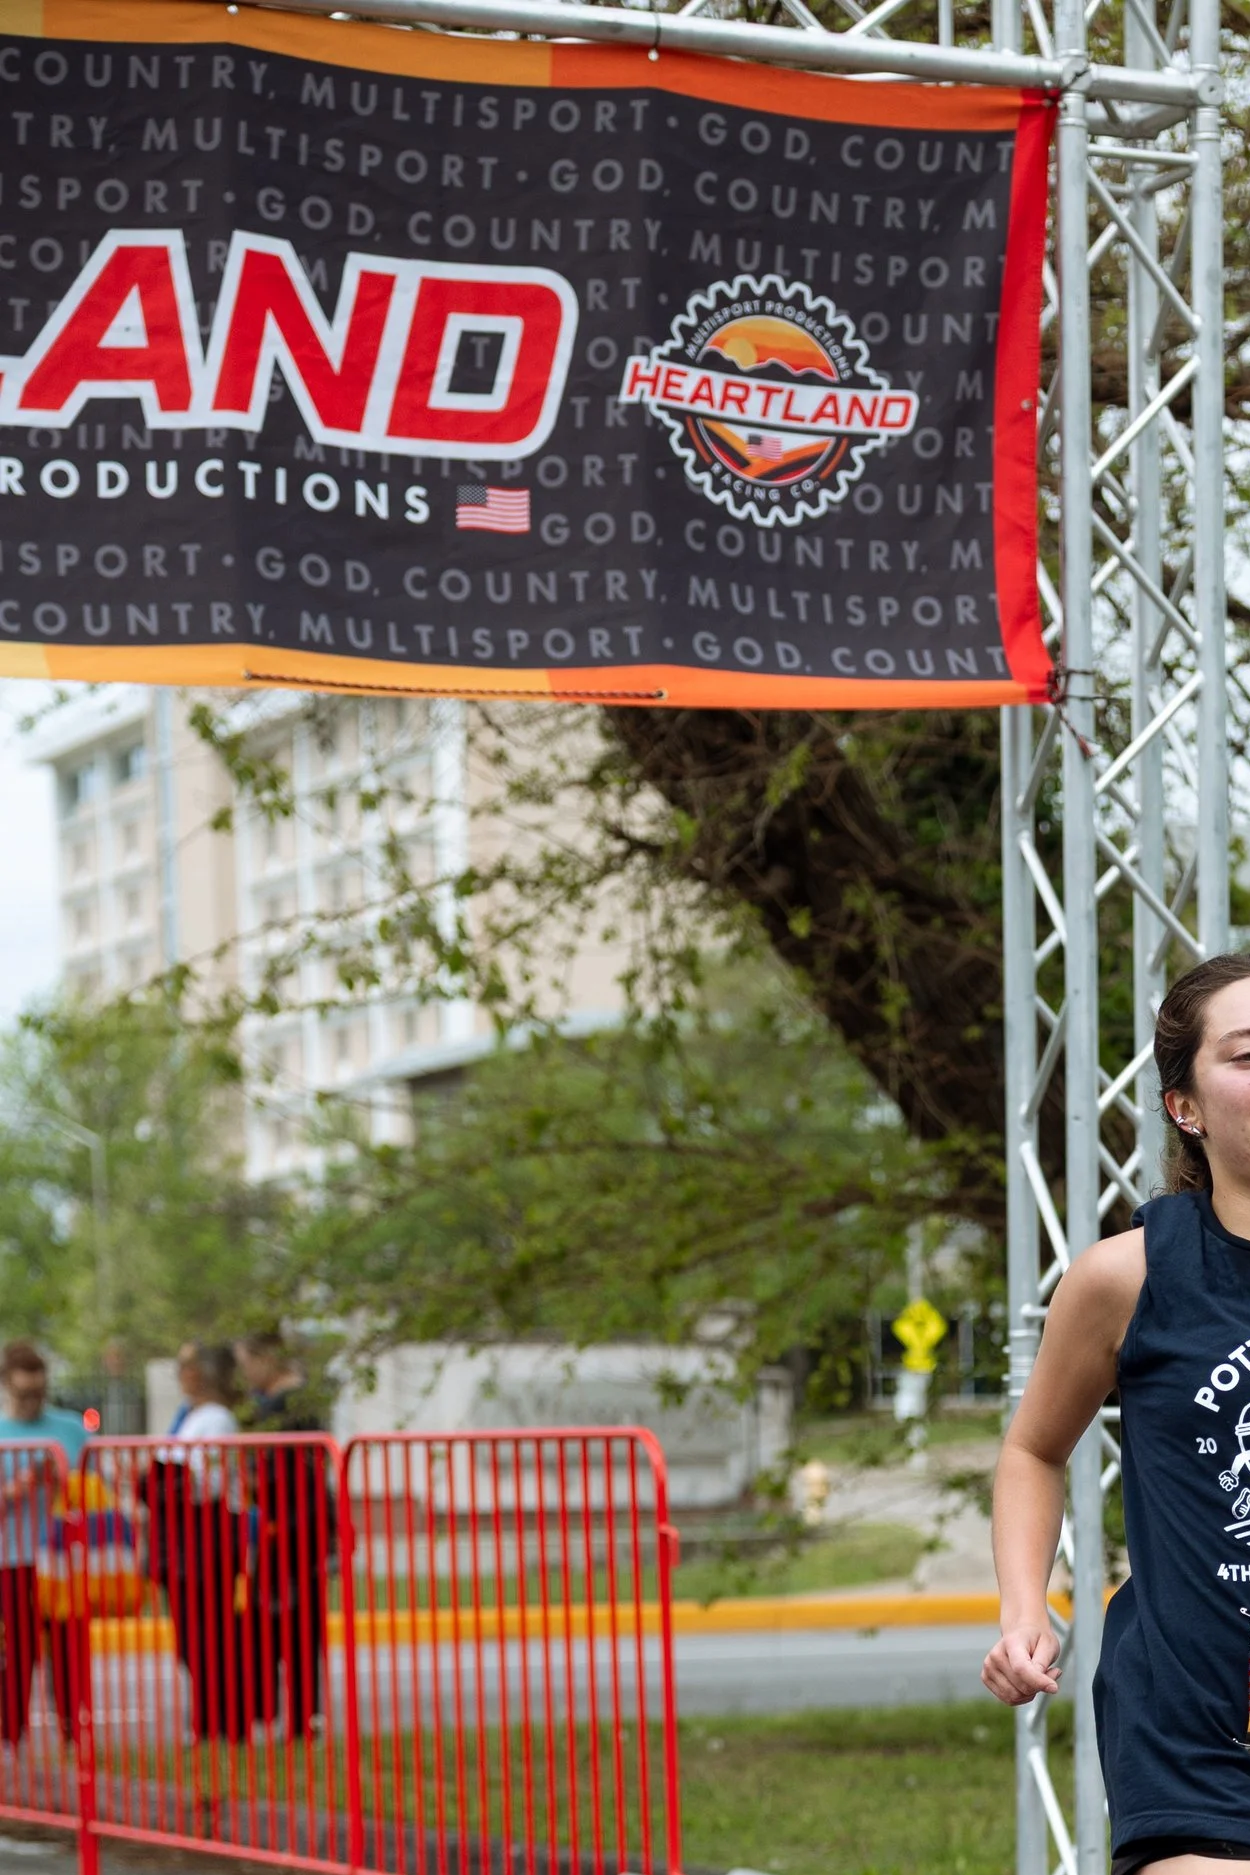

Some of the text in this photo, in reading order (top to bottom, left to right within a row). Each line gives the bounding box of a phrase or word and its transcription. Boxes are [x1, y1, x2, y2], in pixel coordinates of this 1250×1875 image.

[301, 72, 649, 133] MULTISPORT
[699, 112, 817, 166] GOD,
[141, 117, 498, 190] MULTISPORT
[549, 158, 669, 198] GOD,
[694, 170, 940, 234] COUNTRY,
[257, 186, 382, 243] GOD,
[407, 210, 668, 257] COUNTRY,
[688, 229, 1005, 288] MULTISPOR
[685, 299, 761, 359] MULTISPORT
[764, 300, 853, 380] PRODUCTIONS
[626, 357, 914, 430] HEARTLAND
[711, 461, 821, 501] RACING CO.
[540, 511, 664, 549] GOD,
[684, 518, 928, 573] COUNTRY,
[255, 546, 380, 598] GOD,
[403, 566, 667, 605] COUNTRY,
[688, 574, 996, 627] MULTISPOR
[300, 609, 643, 661] MULTISPORT
[692, 630, 813, 673] GOD,
[1196, 1437, 1218, 1454] 20
